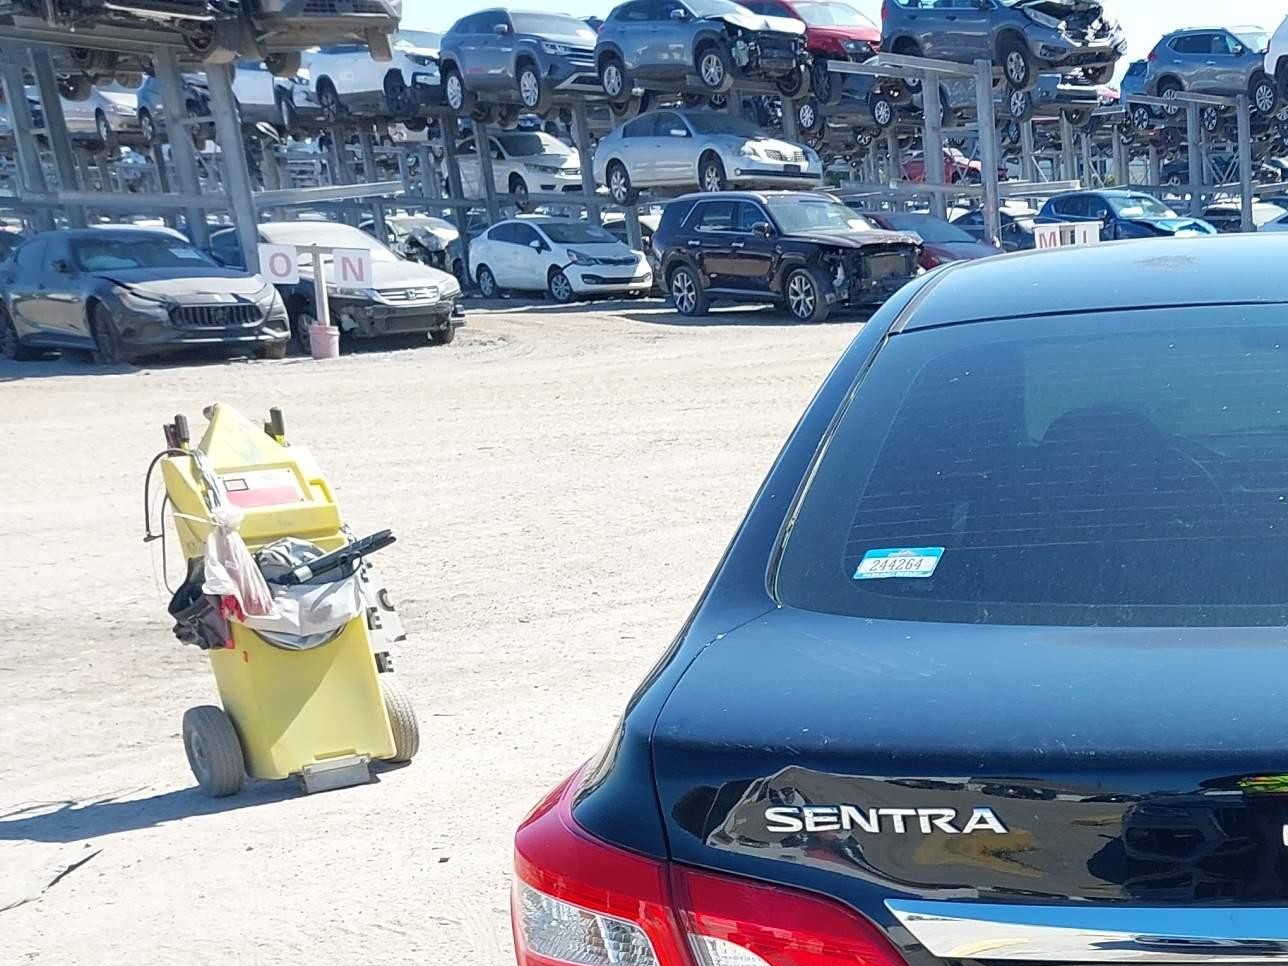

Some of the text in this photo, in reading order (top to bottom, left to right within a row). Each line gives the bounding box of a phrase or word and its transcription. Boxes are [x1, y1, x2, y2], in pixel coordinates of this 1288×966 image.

[1039, 231, 1057, 248] M
[269, 252, 364, 282] O N
[868, 558, 924, 573] 244264
[764, 804, 1009, 834] SENTRA
